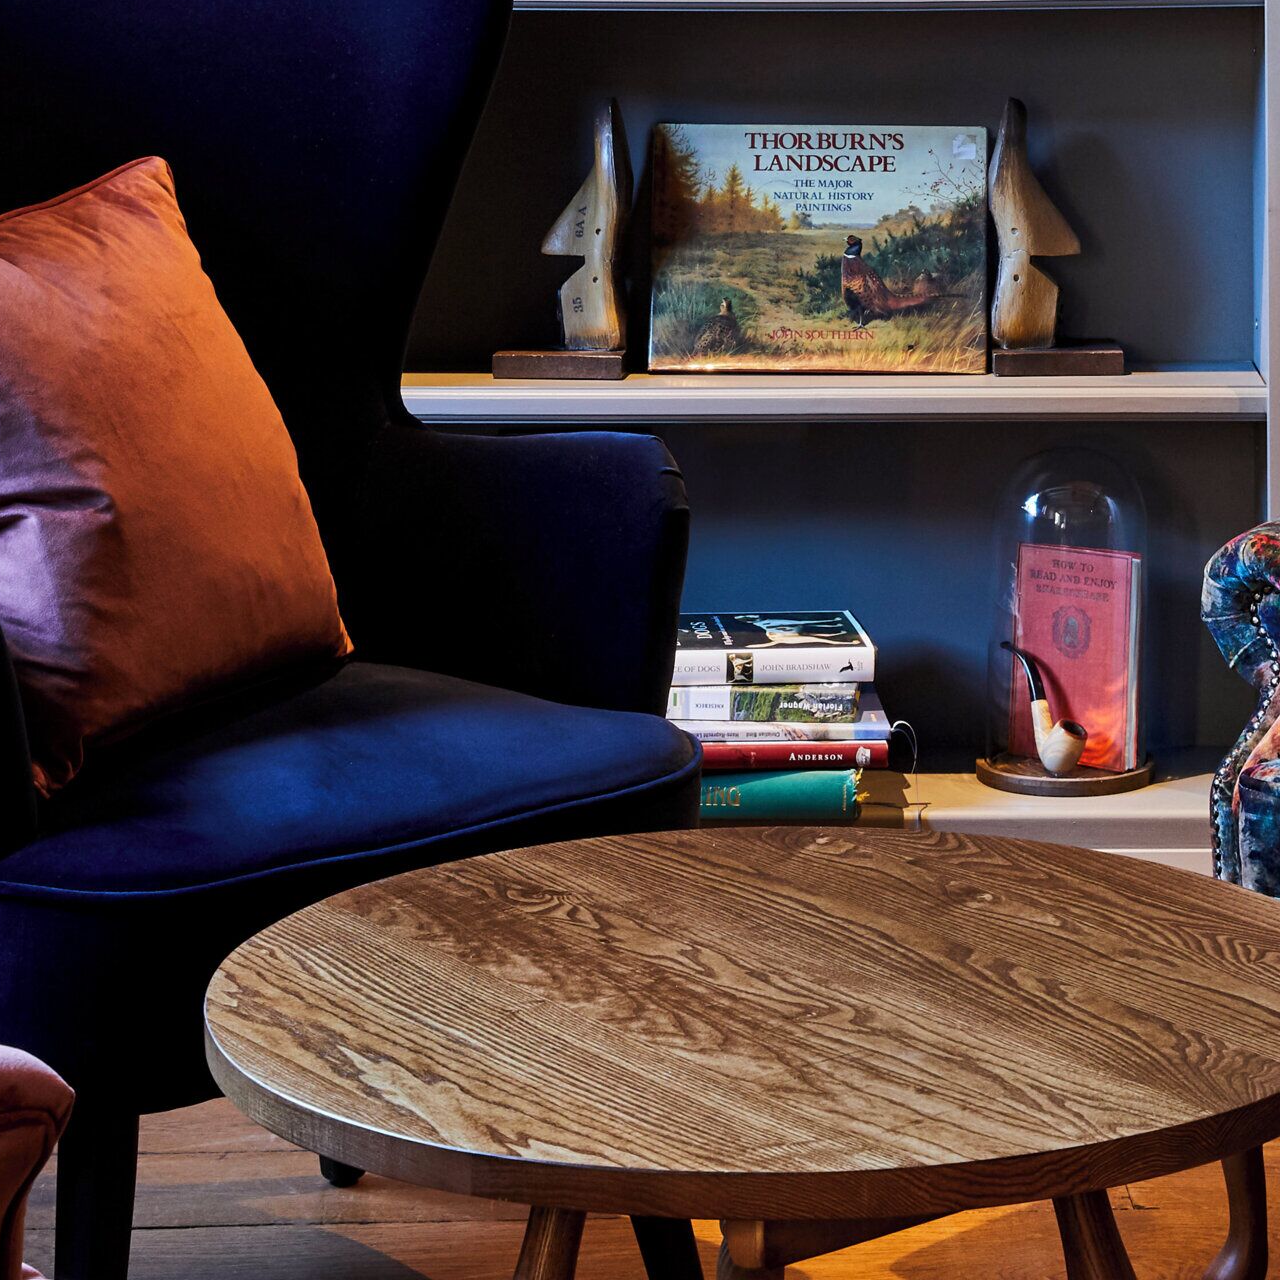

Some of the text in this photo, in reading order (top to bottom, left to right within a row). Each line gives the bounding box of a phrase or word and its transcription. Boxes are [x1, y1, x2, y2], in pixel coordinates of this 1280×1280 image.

[745, 132, 904, 151] THORBURN'S
[753, 154, 896, 172] LANDSCAPE
[793, 179, 854, 189] THE MAJOR
[773, 191, 874, 201] NATURAL HISTORY
[795, 202, 852, 212] PAINTINGS
[770, 329, 874, 341] JOHN SOUTHERN
[1052, 559, 1095, 573] HOW TO
[1029, 569, 1118, 590] READ AND ENJOY
[760, 663, 832, 671] JOHN BRADSHAW
[779, 701, 843, 711] Florian Wagner
[789, 752, 843, 761] ANDERSON
